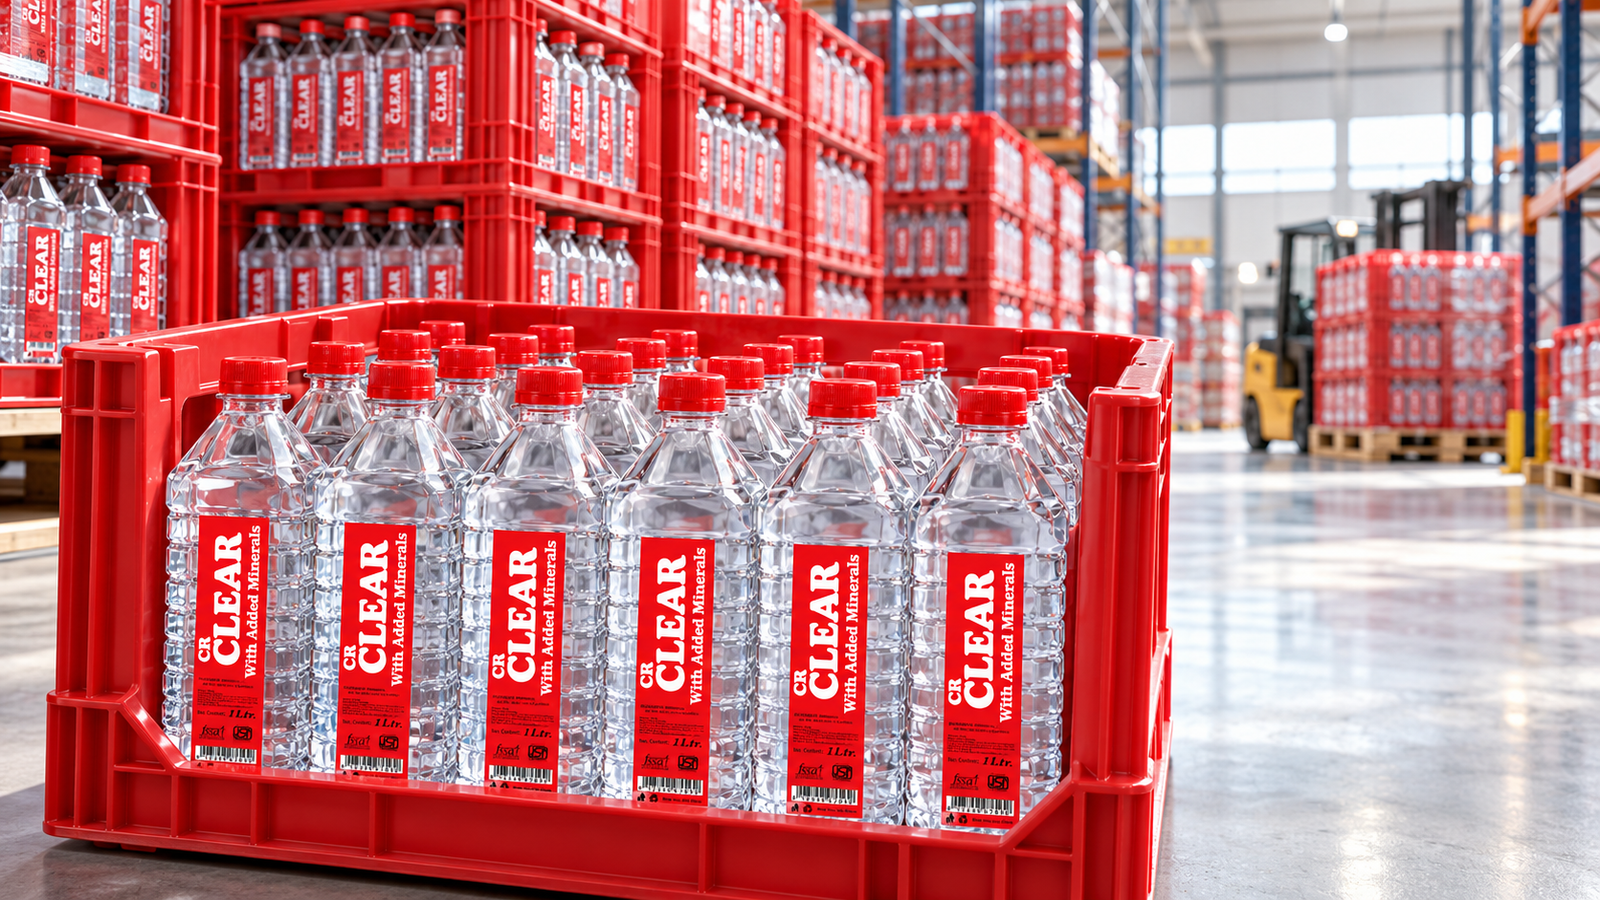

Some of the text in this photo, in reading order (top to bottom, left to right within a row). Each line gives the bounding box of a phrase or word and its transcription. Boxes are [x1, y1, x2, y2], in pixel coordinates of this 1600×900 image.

[91, 0, 102, 46] CLEA
[143, 5, 154, 62] CLEAR
[389, 72, 402, 124] CLEAR
[435, 70, 447, 122] CLEAR
[34, 234, 49, 306] CLEAR
[88, 241, 102, 308] CLEAR
[138, 247, 151, 311] CLEAR
[212, 532, 243, 666] CLEAR
[245, 525, 261, 679] With Added Minerals
[358, 539, 389, 674] CLEAR
[391, 532, 407, 687] With Added Minerals
[507, 546, 538, 683] CLEAR
[540, 540, 557, 697] With Added Minerals
[655, 554, 687, 692] CLEAR
[690, 547, 706, 705] With Added Minerals
[809, 561, 840, 700] CLEAR
[198, 636, 211, 663] CR
[343, 644, 356, 671] CR
[492, 653, 505, 680] CR
[844, 554, 860, 714] With Added Minerals
[963, 570, 995, 709] CLEAR
[999, 562, 1015, 723] With Added Minerals
[639, 661, 654, 689] CR
[793, 669, 807, 697] CR
[948, 678, 962, 706] CR
[235, 709, 256, 720] Ltr.
[382, 718, 403, 729] Ltr.
[835, 747, 856, 757] Ltr.
